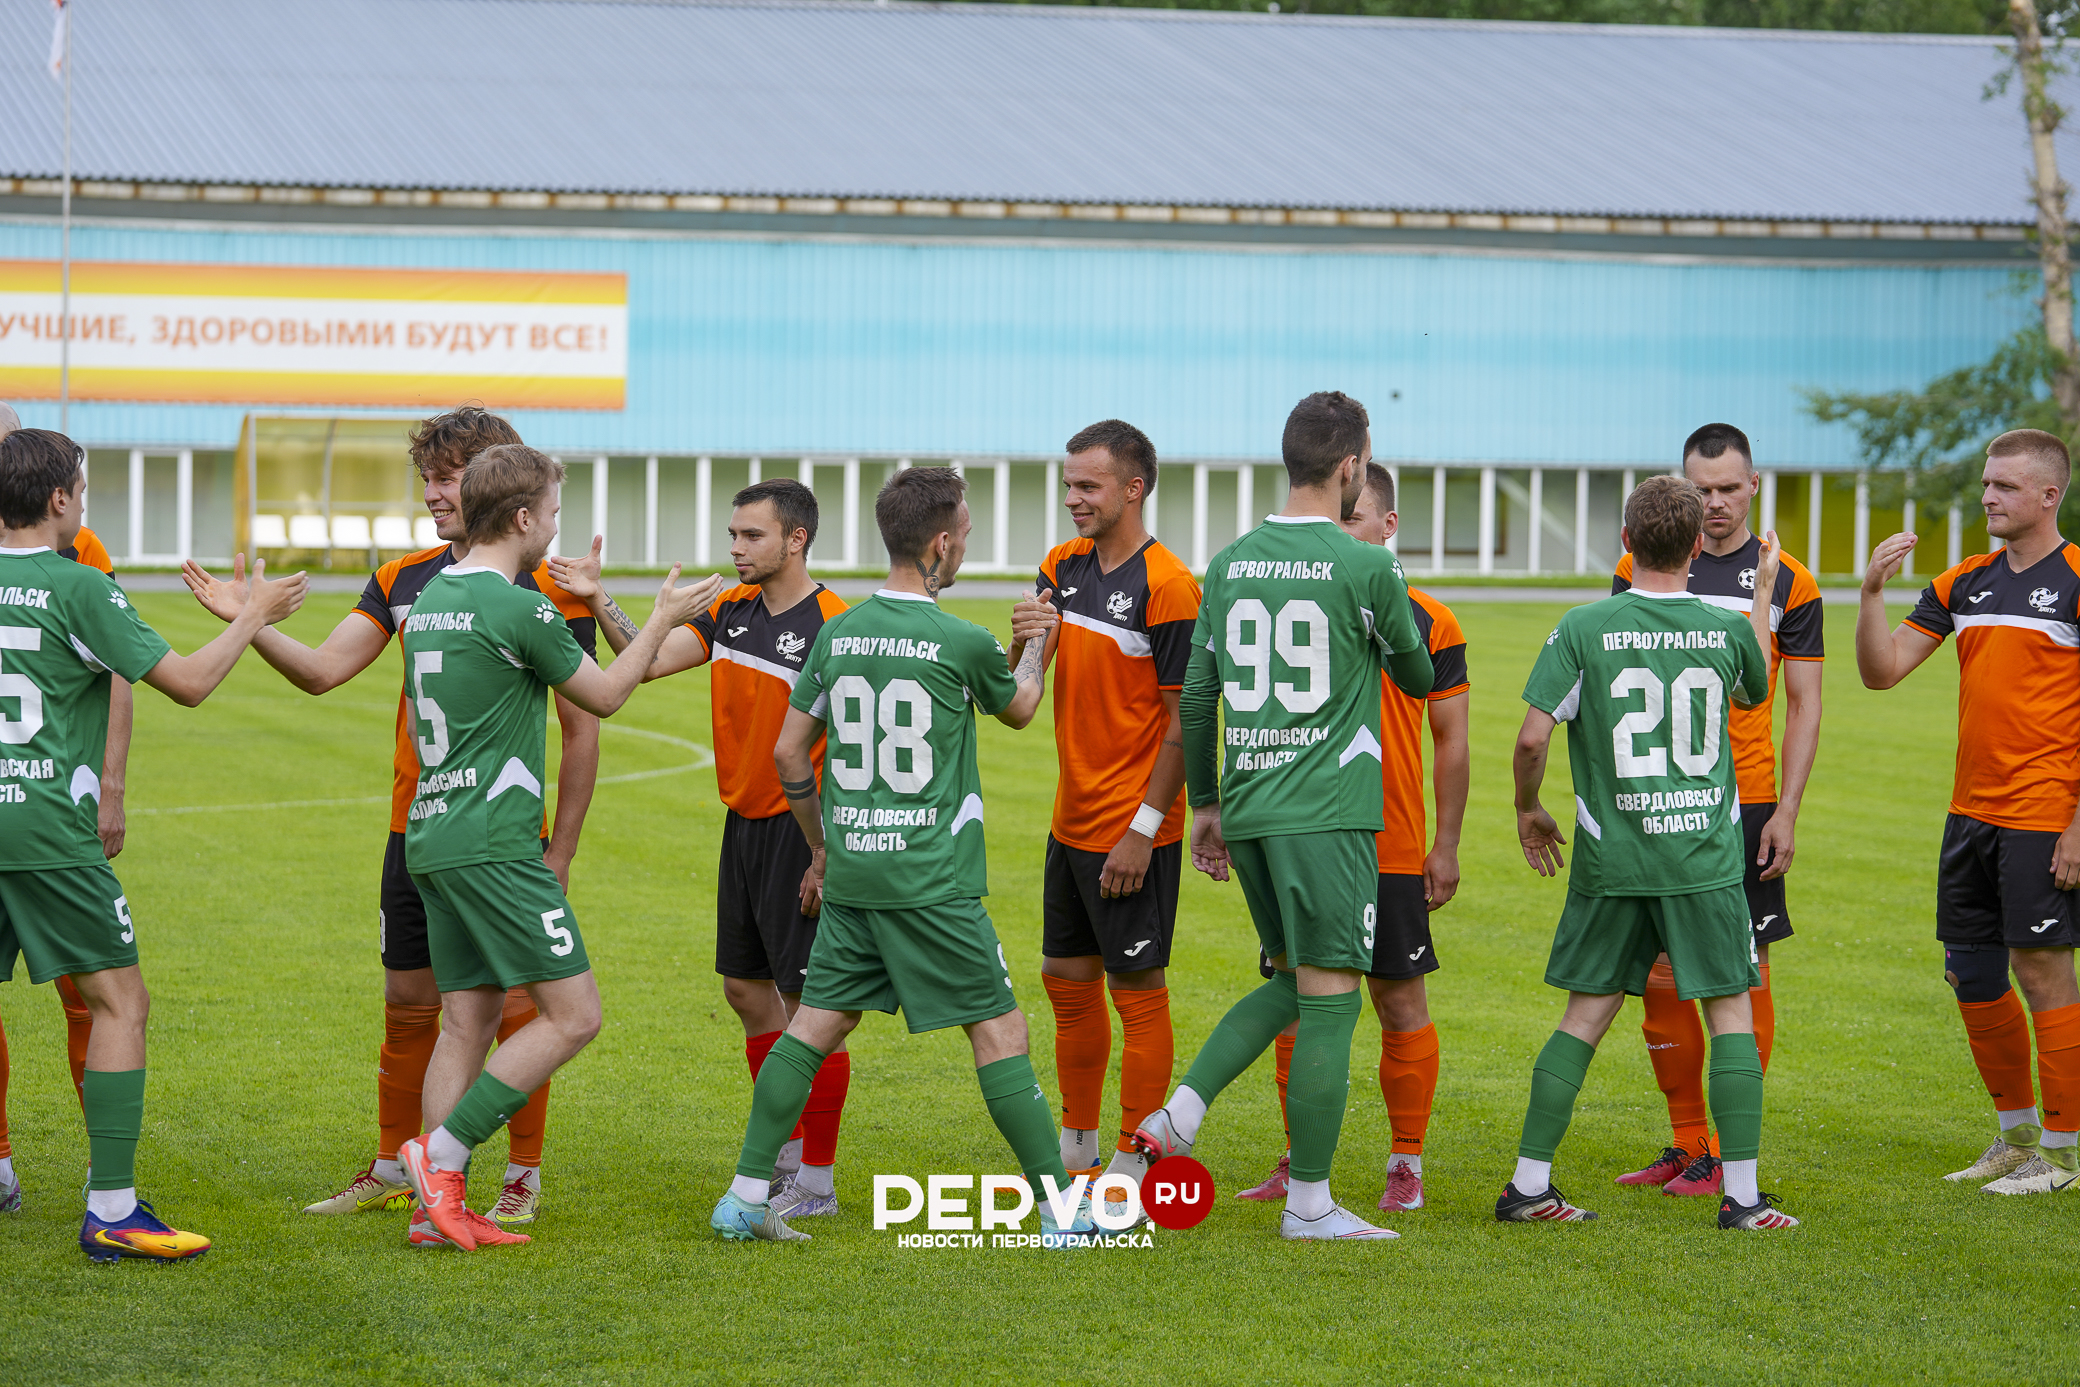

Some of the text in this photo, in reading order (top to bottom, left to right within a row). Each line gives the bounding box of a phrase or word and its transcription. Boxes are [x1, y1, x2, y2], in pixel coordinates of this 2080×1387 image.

[151, 315, 396, 348] ЗДОРОВЫМИ
[407, 322, 519, 354] БУДУТ
[530, 324, 608, 350] ВСЕ!
[1226, 560, 1334, 581] ПЕРВОУРАЛЬСК
[831, 636, 942, 662] ПЕРВОУРАЛЬСК
[1224, 598, 1331, 714] 99
[1602, 630, 1727, 651] ПЕРВОУРАЛЬСК
[413, 651, 450, 767] 5
[1610, 667, 1723, 779] 20
[829, 675, 934, 794] 98
[1616, 785, 1726, 813] СВЕРДЛОВСКА
[845, 832, 907, 852] ОБЛАСТЬ
[1642, 812, 1710, 835] ОБЛАСТЬ
[113, 893, 135, 945] 5
[540, 907, 575, 957] 5
